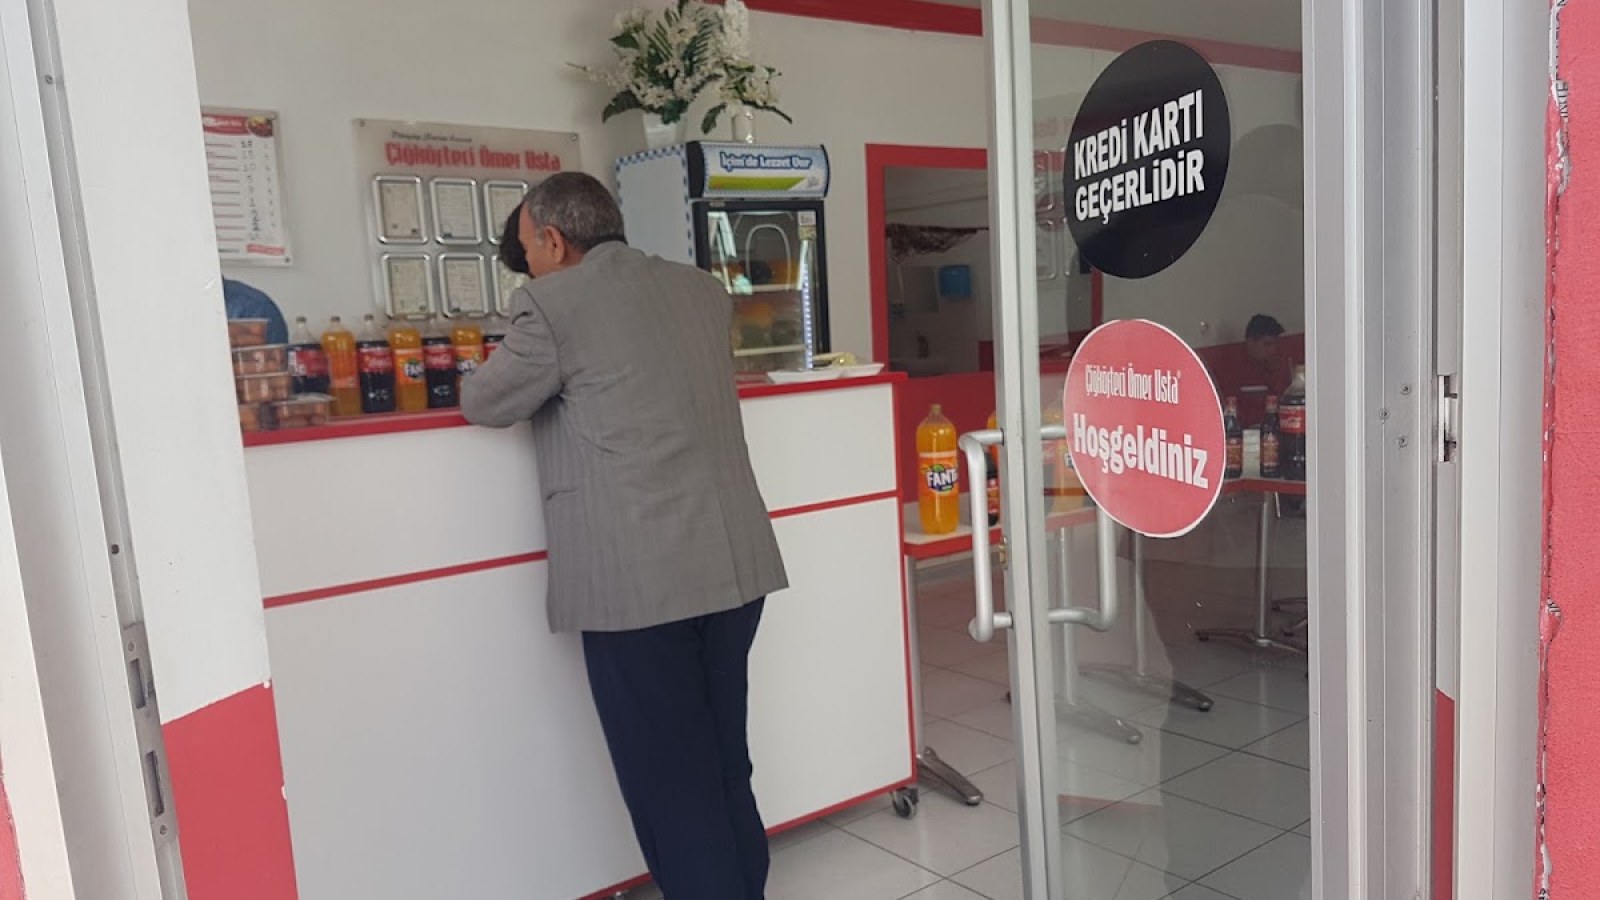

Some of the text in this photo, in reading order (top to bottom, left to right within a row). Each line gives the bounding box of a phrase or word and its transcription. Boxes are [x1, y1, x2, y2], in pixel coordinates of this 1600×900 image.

[525, 150, 561, 171] Usta
[1074, 89, 1204, 180] KREDİ KARTI
[1075, 149, 1205, 224] GEÇERLİDİR
[1127, 362, 1153, 401] Ömer
[1072, 412, 1209, 489] Hoşgeldiniz
